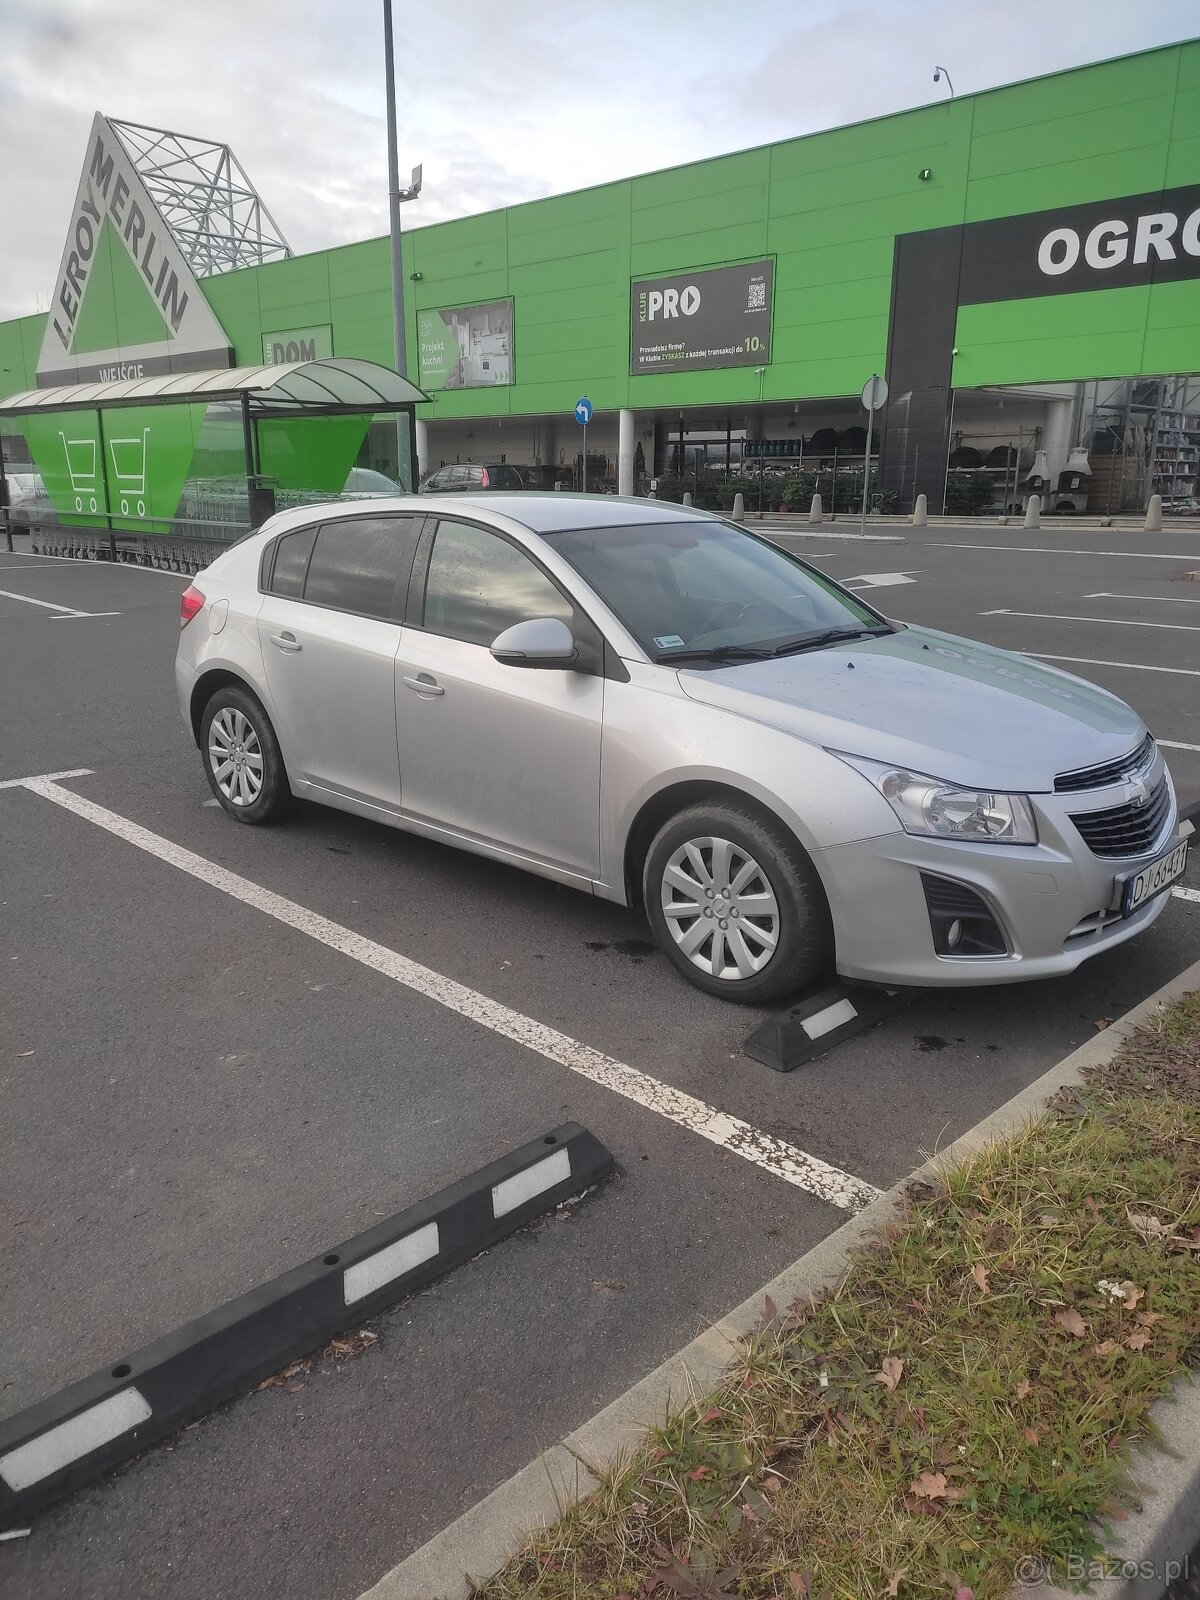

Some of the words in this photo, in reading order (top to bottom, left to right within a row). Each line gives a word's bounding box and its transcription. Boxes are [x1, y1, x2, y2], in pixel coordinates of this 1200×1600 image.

[90, 135, 189, 334] MERLIN
[53, 178, 101, 351] LEROY
[639, 292, 647, 322] KLUB
[648, 285, 701, 321] PRO
[273, 338, 316, 365] DOM
[422, 341, 444, 353] Projekt
[640, 345, 668, 353] Prowadzisz
[645, 354, 661, 362] Klubie
[661, 351, 685, 360] ZYSKASZ
[690, 349, 706, 358] każdej
[707, 346, 735, 356] transakcji
[736, 345, 743, 353] do
[99, 361, 144, 383] WEJŚCIE
[422, 354, 443, 366] kuchni
